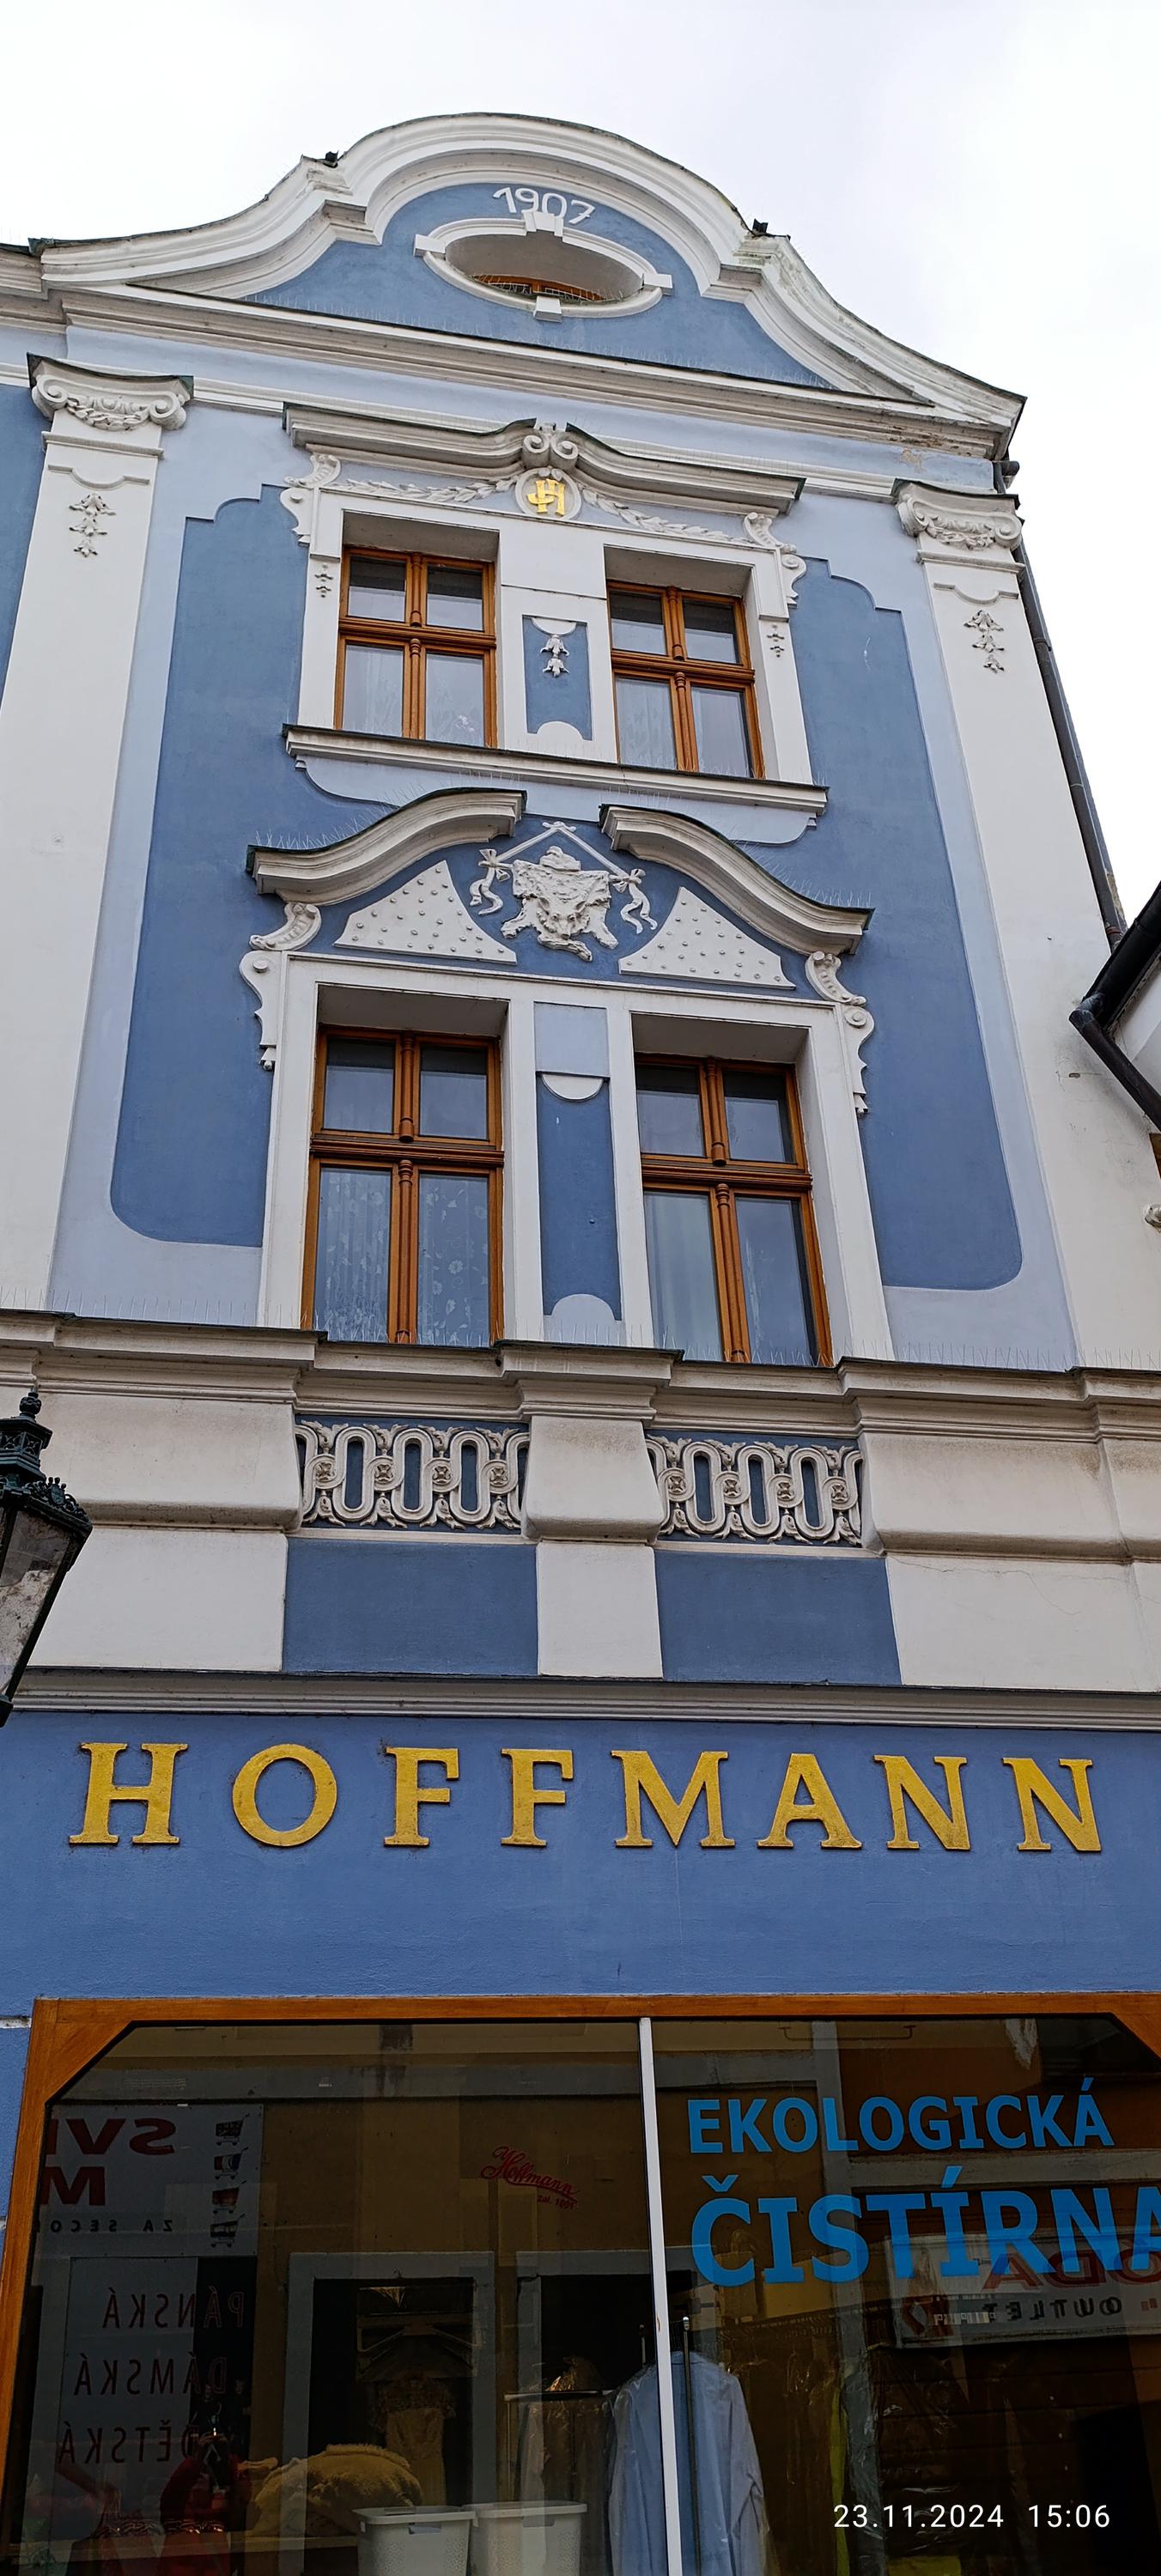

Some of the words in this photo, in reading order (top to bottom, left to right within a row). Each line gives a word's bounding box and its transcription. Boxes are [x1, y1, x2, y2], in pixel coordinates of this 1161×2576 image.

[492, 186, 596, 225] 1907
[69, 1743, 1103, 1852] HOFFMANN
[688, 2076, 1115, 2154] EKOLOGICKÁ
[691, 2166, 1161, 2287] ČISTÍRNA
